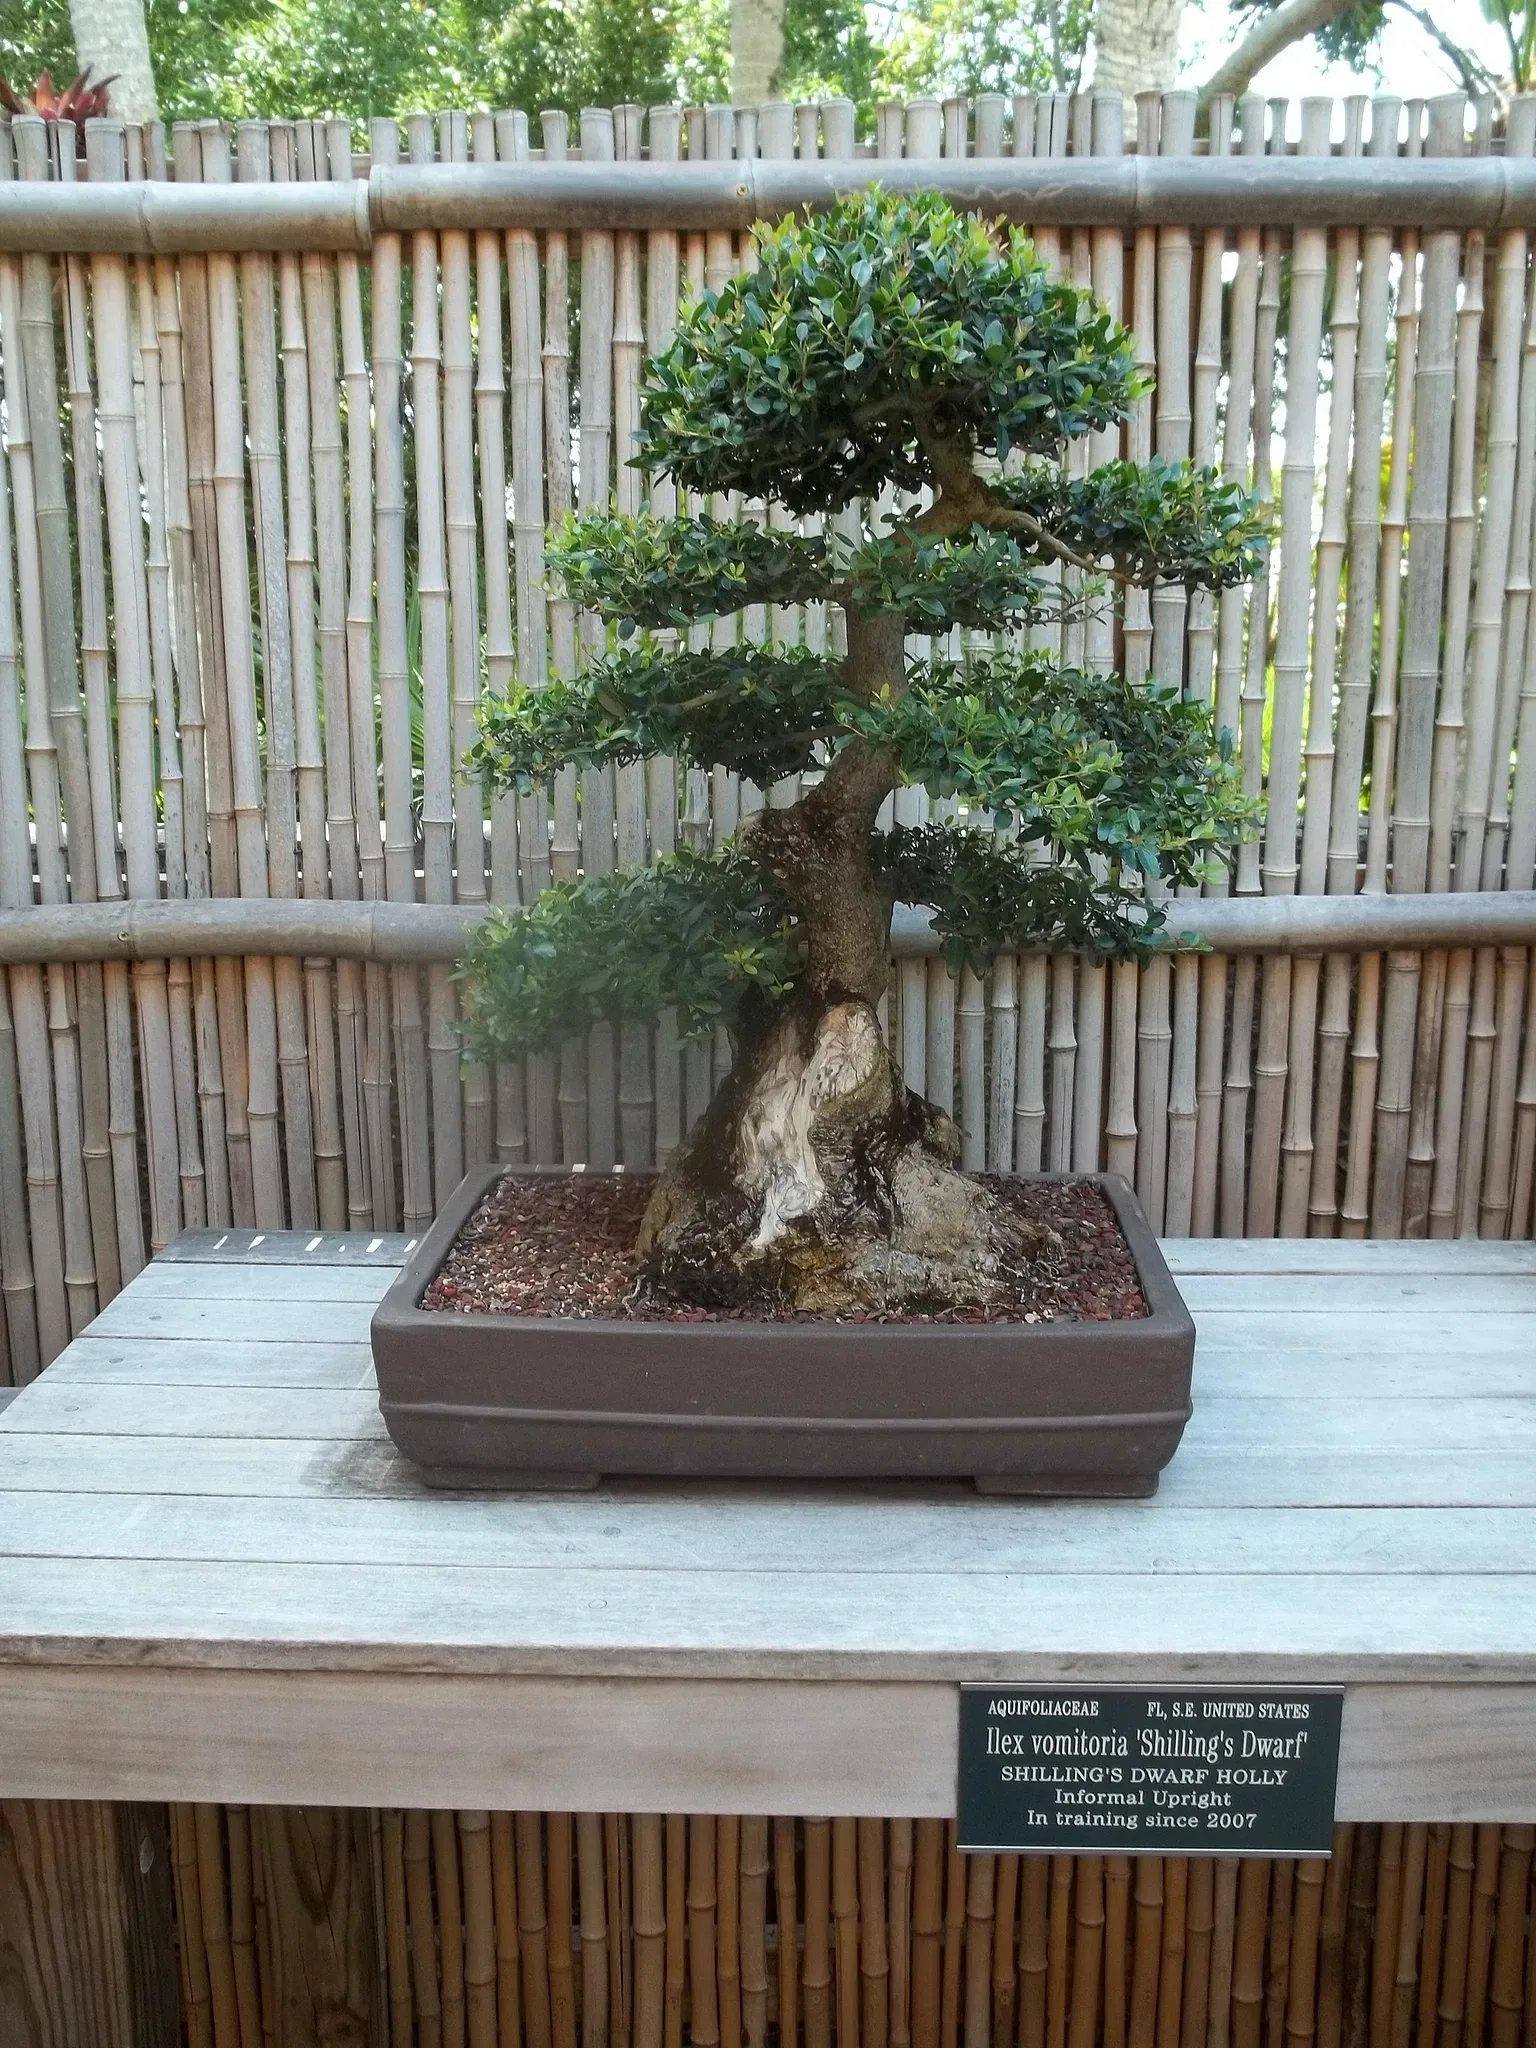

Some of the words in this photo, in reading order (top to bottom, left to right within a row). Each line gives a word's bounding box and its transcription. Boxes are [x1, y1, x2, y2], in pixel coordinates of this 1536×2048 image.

[988, 1700, 1099, 1717] AQUIFOLIACEAE
[1147, 1702, 1168, 1720] FL,
[1172, 1702, 1197, 1718] S.E.
[1202, 1702, 1254, 1718] UNITED
[1258, 1703, 1310, 1719] STATES
[986, 1727, 1024, 1755] Ilex
[1032, 1728, 1128, 1756] vomitoria
[1136, 1729, 1234, 1764] 'Shilling's
[1241, 1731, 1308, 1759] Dwarf'
[1001, 1766, 1122, 1782] SHILLING'S
[1130, 1768, 1209, 1784] DWARF
[1216, 1770, 1288, 1785] HOLLY
[1055, 1790, 1144, 1805] Informal
[1153, 1791, 1231, 1808] Upright
[1027, 1810, 1048, 1825] In
[1056, 1812, 1138, 1829] training
[1146, 1812, 1198, 1828] since
[1207, 1813, 1257, 1828] 2007
